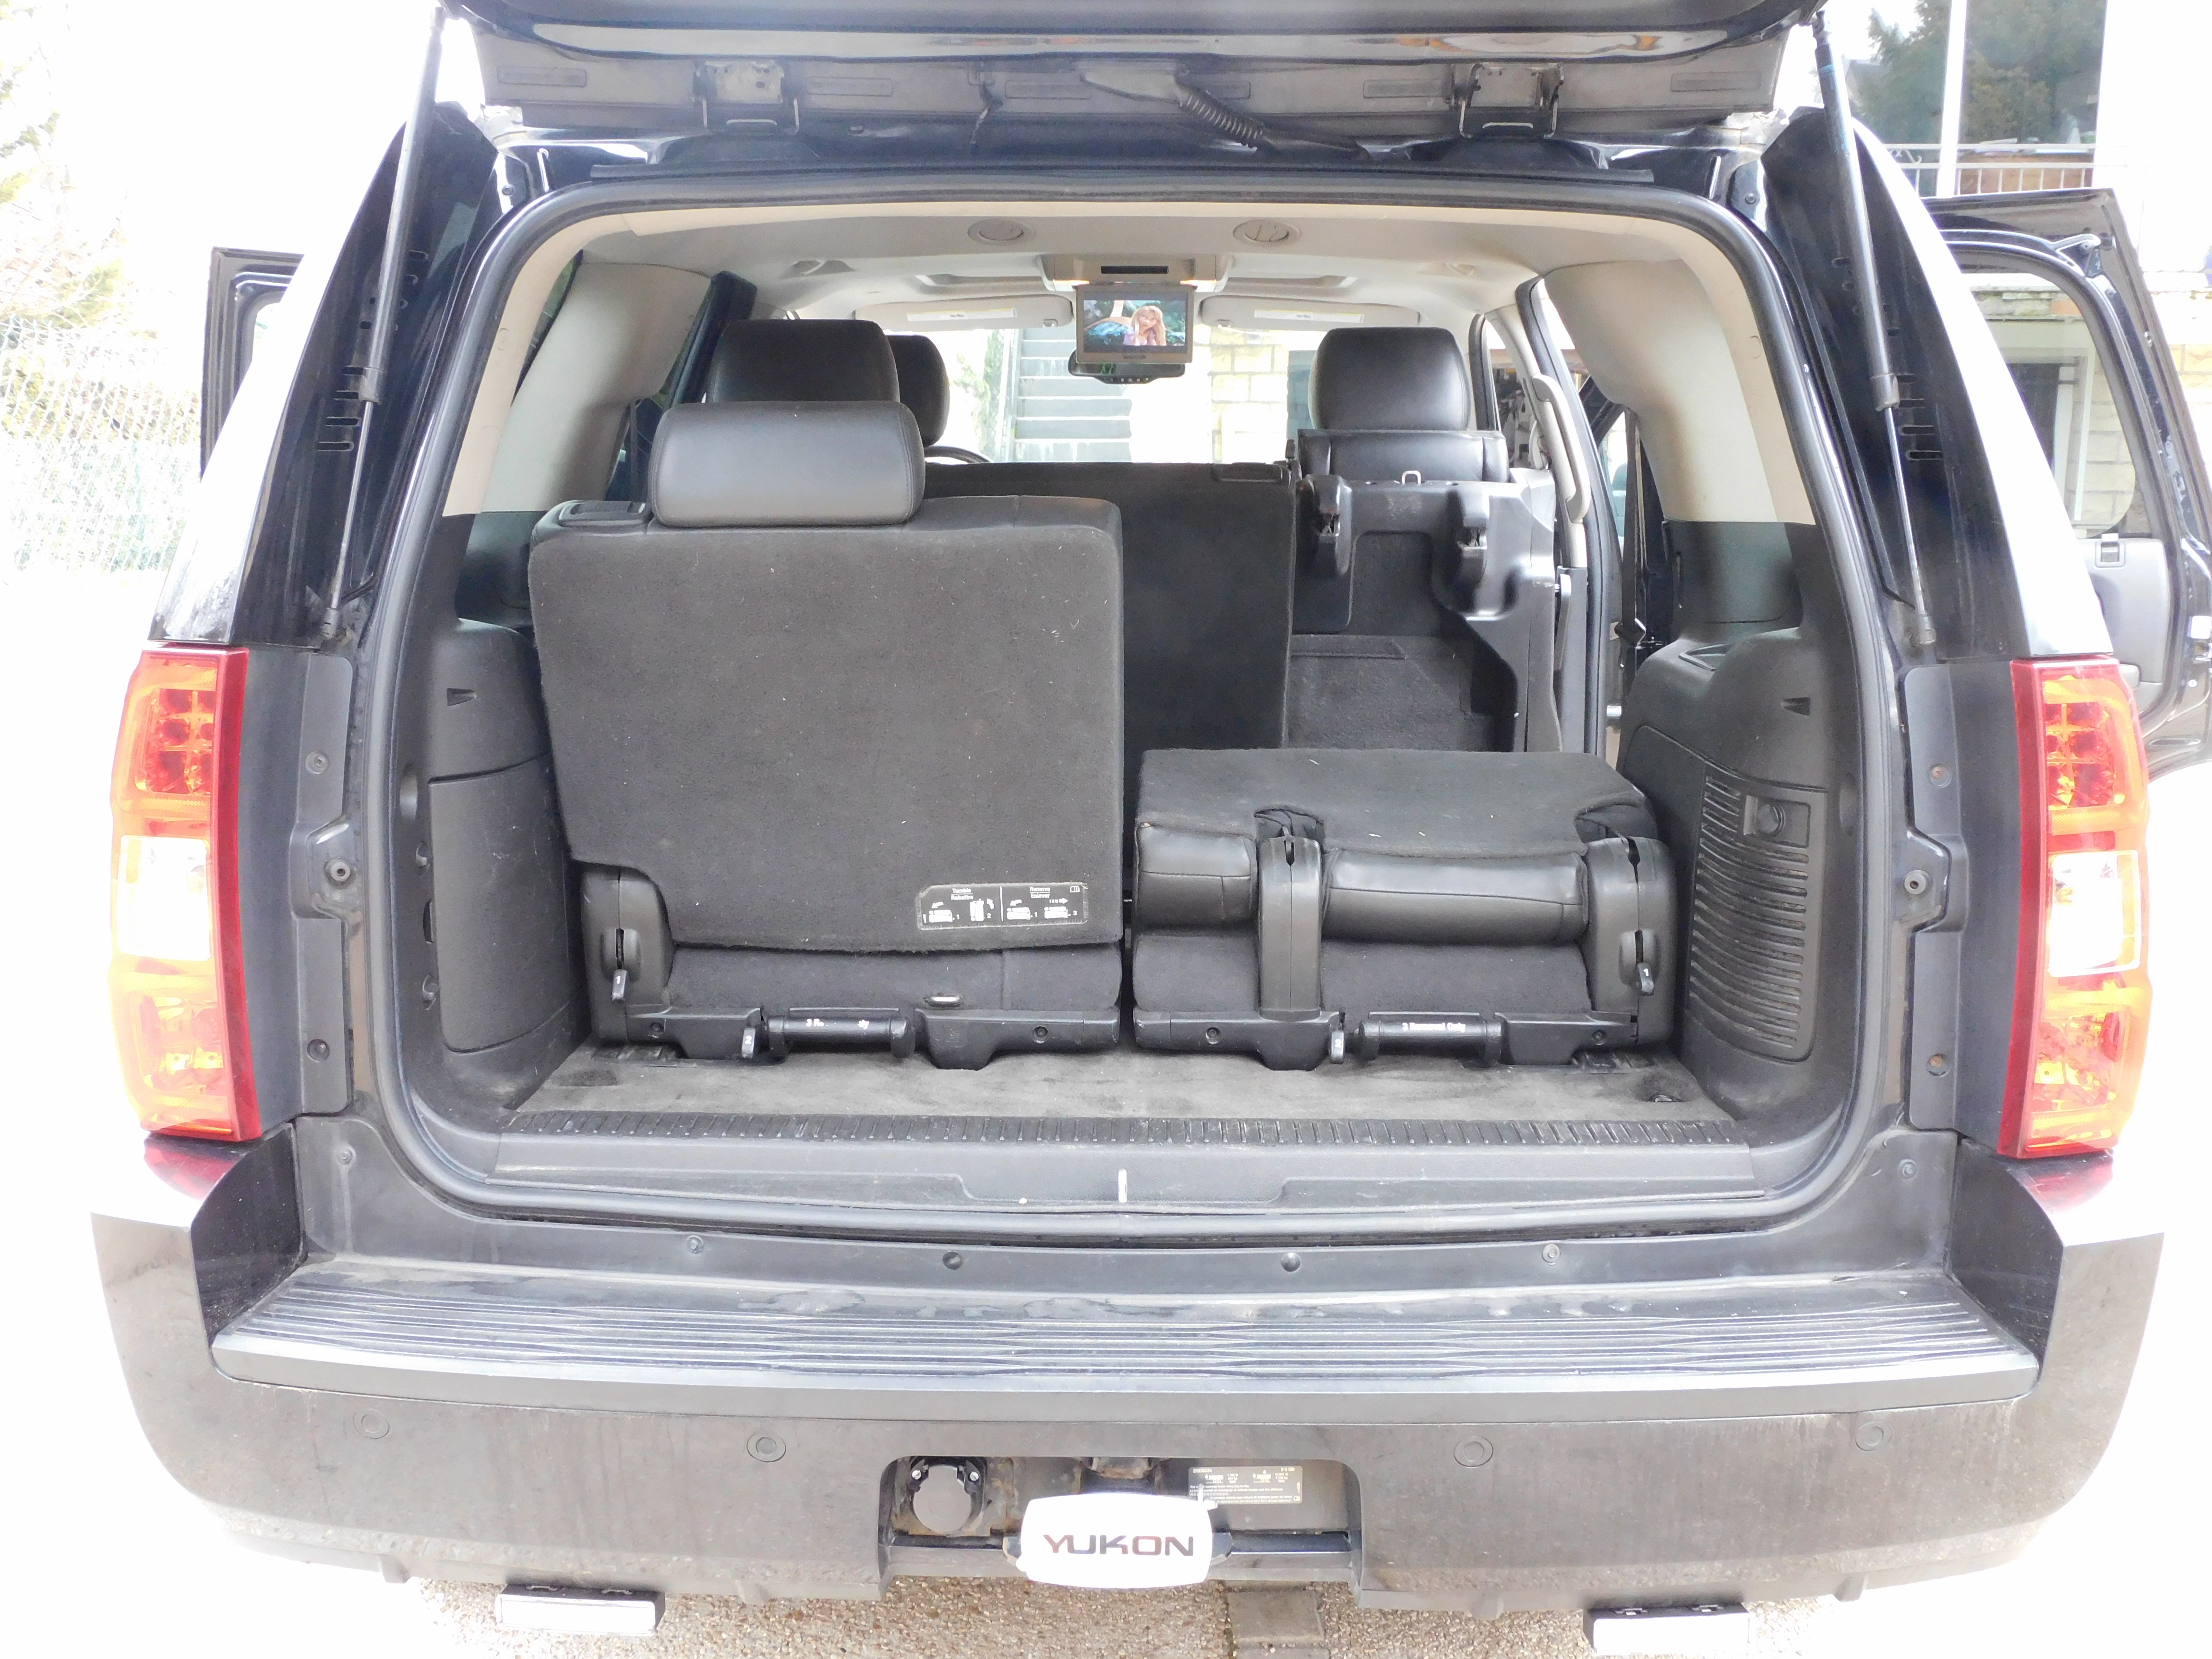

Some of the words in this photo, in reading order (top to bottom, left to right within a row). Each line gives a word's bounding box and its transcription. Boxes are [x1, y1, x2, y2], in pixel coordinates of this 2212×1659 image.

[1643, 968, 1649, 976] 1
[806, 1019, 812, 1027] 3
[1402, 1022, 1408, 1031] 3
[1409, 1022, 1446, 1031] Removal
[1447, 1022, 1466, 1033] Only
[745, 1035, 752, 1045] 2
[1334, 1038, 1342, 1048] 2
[1043, 1534, 1194, 1557] YUKON
